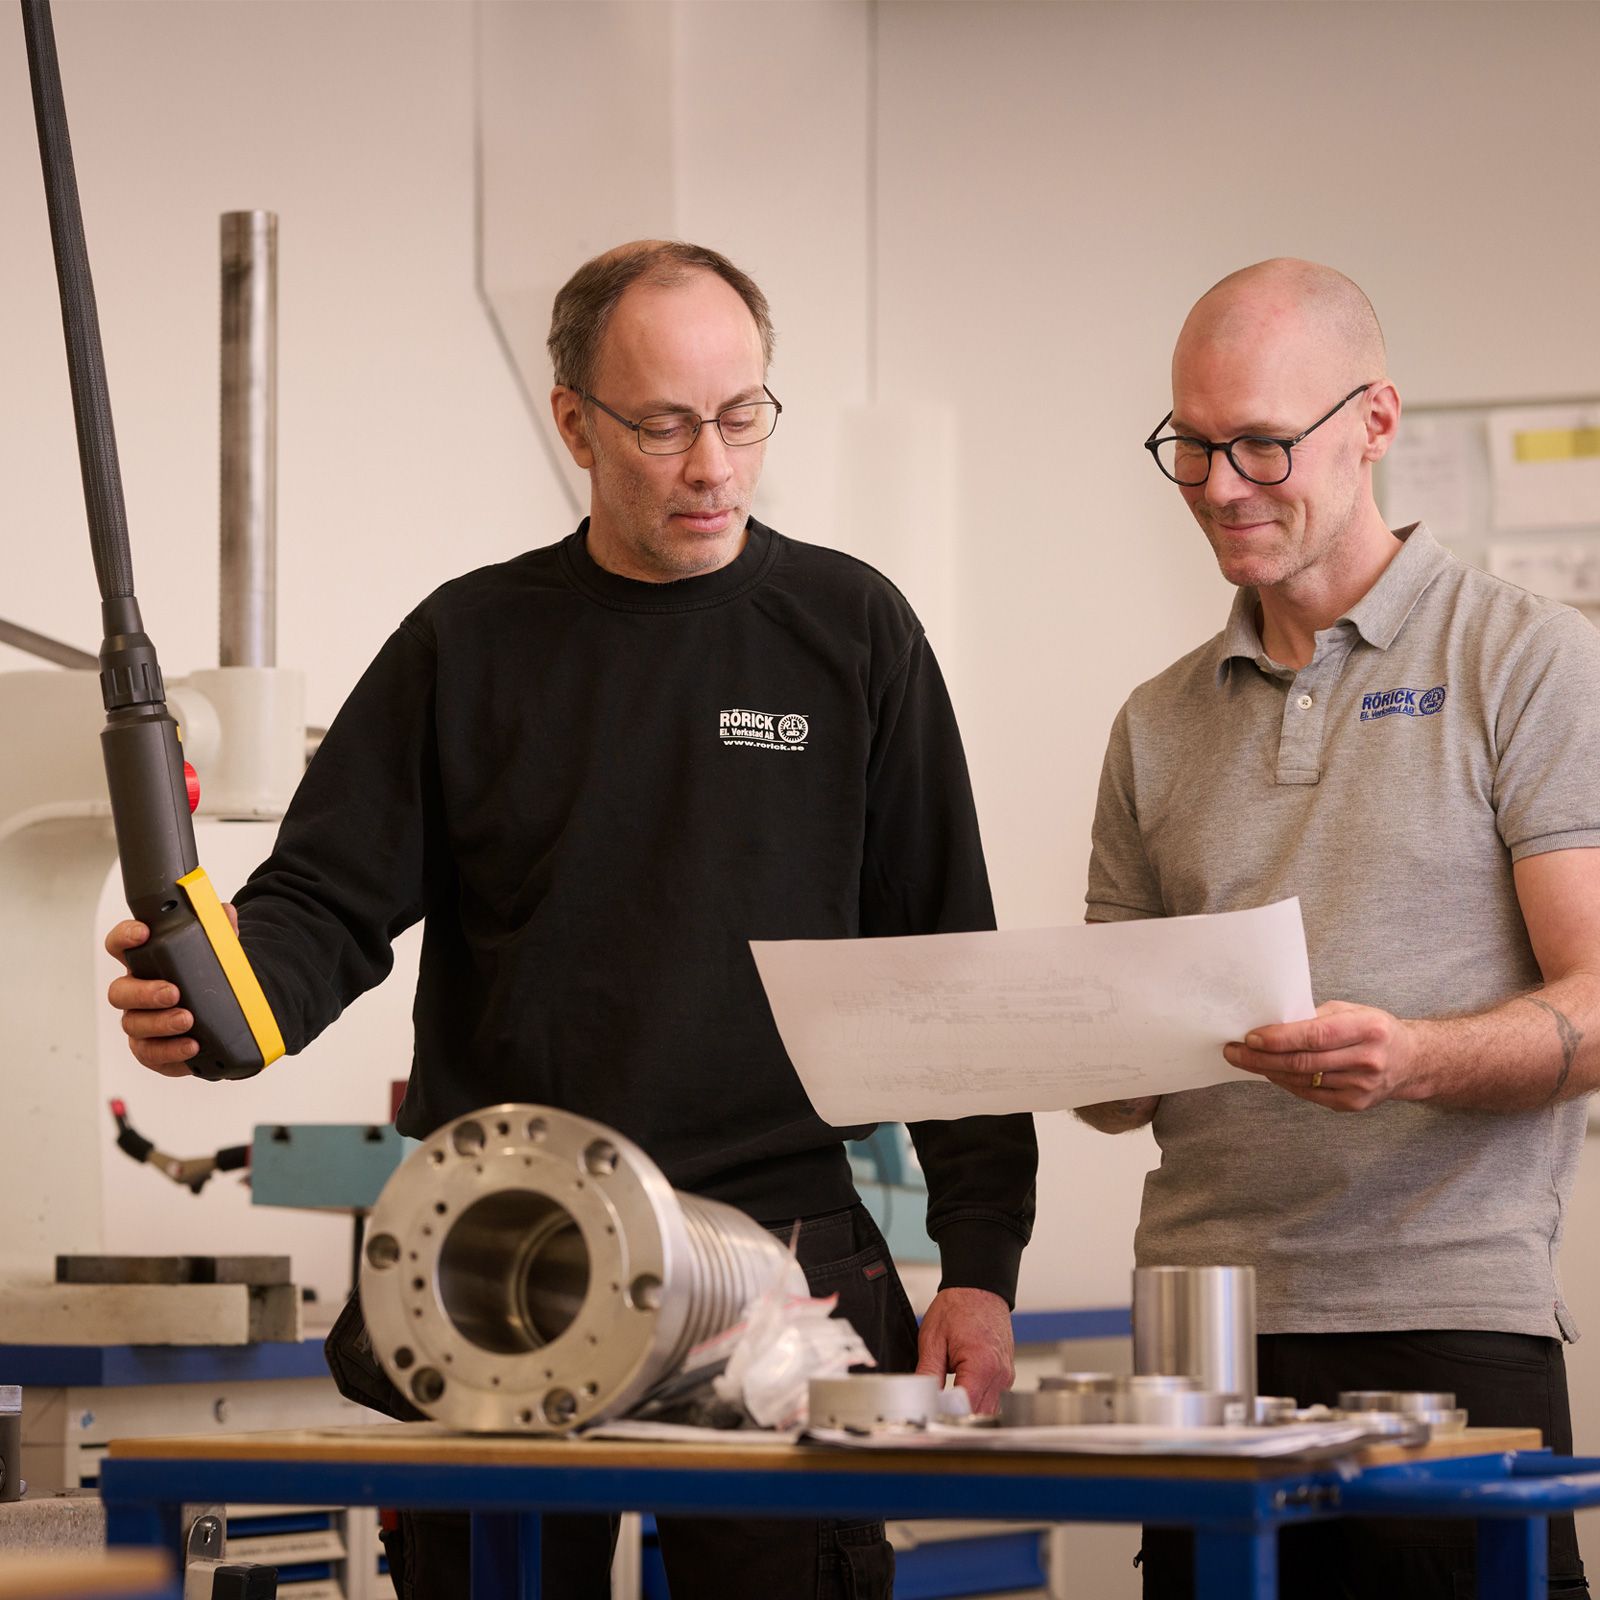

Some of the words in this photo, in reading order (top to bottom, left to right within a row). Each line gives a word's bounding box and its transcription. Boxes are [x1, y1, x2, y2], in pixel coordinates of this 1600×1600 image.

[1362, 690, 1416, 710] RÖRICK
[1402, 705, 1414, 714] AB
[720, 709, 774, 731] RÖRICK
[731, 728, 763, 738] Verkstad
[764, 731, 774, 739] AB
